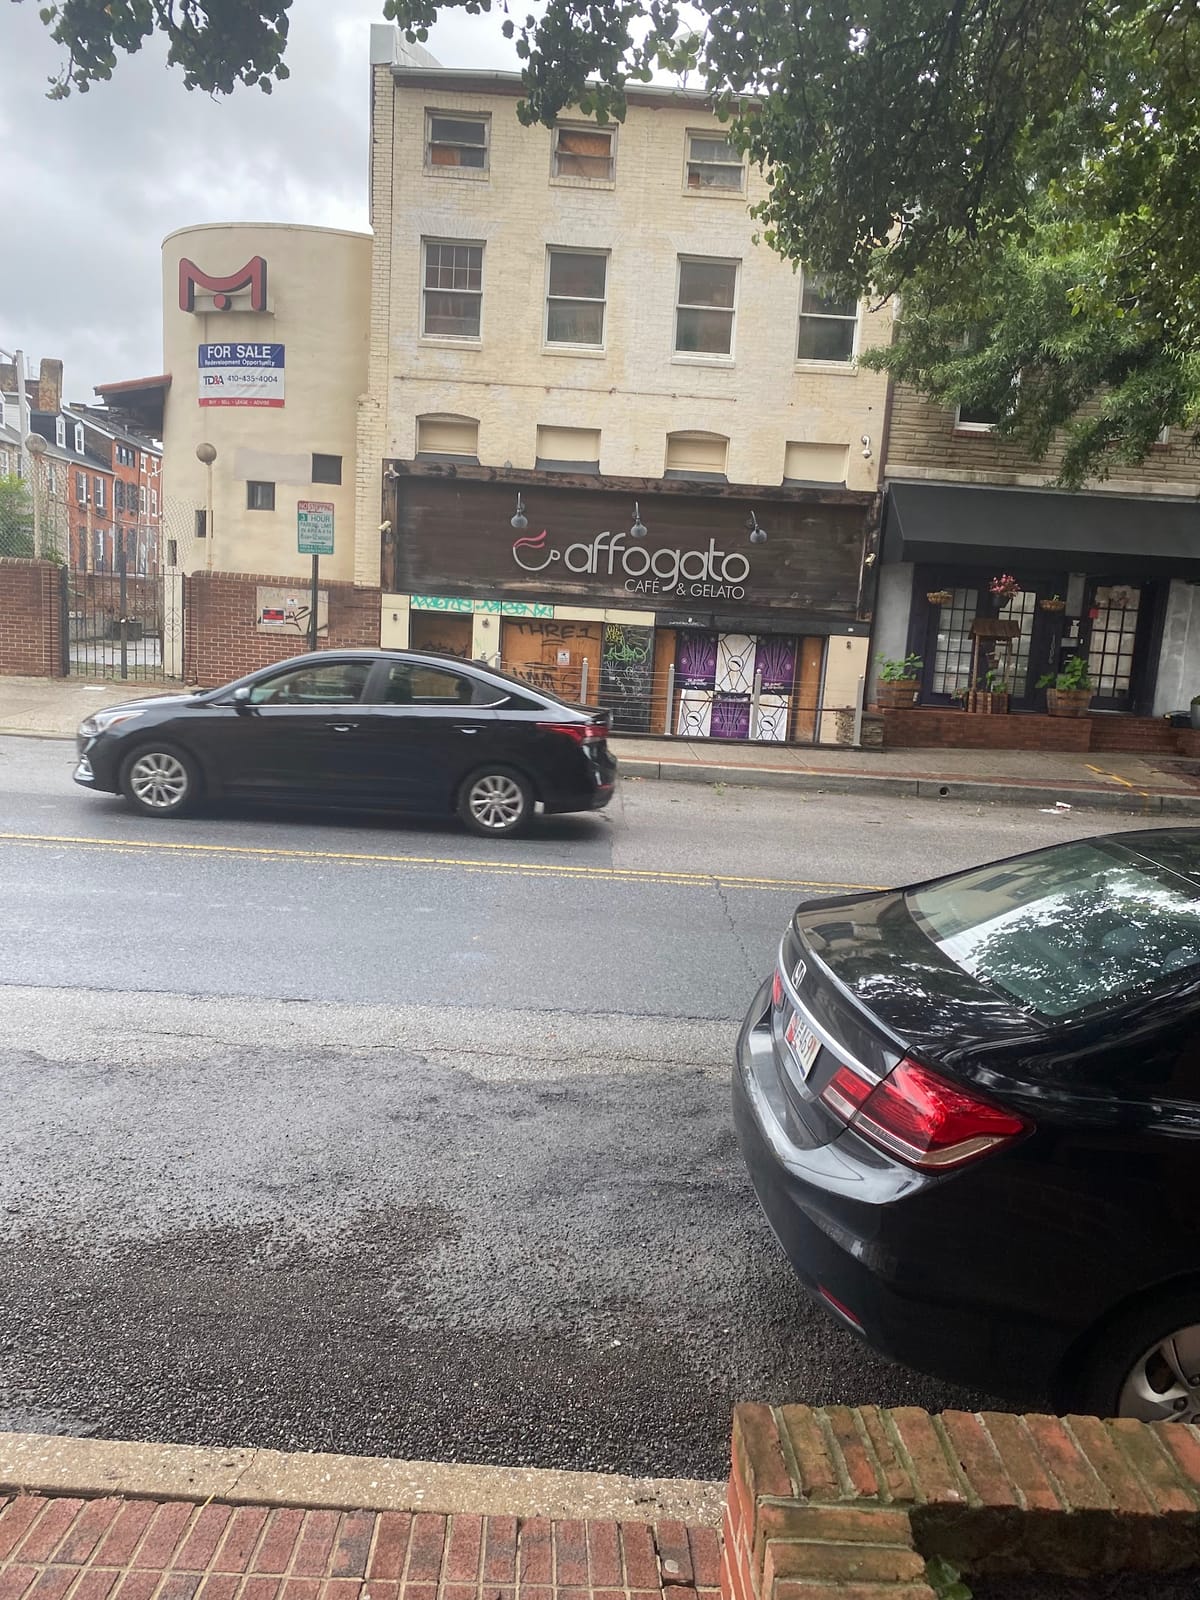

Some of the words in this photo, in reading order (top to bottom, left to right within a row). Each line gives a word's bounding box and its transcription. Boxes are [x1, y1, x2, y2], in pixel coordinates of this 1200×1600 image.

[207, 345, 231, 359] FOR
[236, 345, 272, 359] SALE
[242, 359, 275, 367] Opportunity
[564, 531, 750, 592] affogato
[624, 578, 660, 594] CAFÉ
[676, 582, 686, 596] &
[690, 583, 745, 600] GELATO
